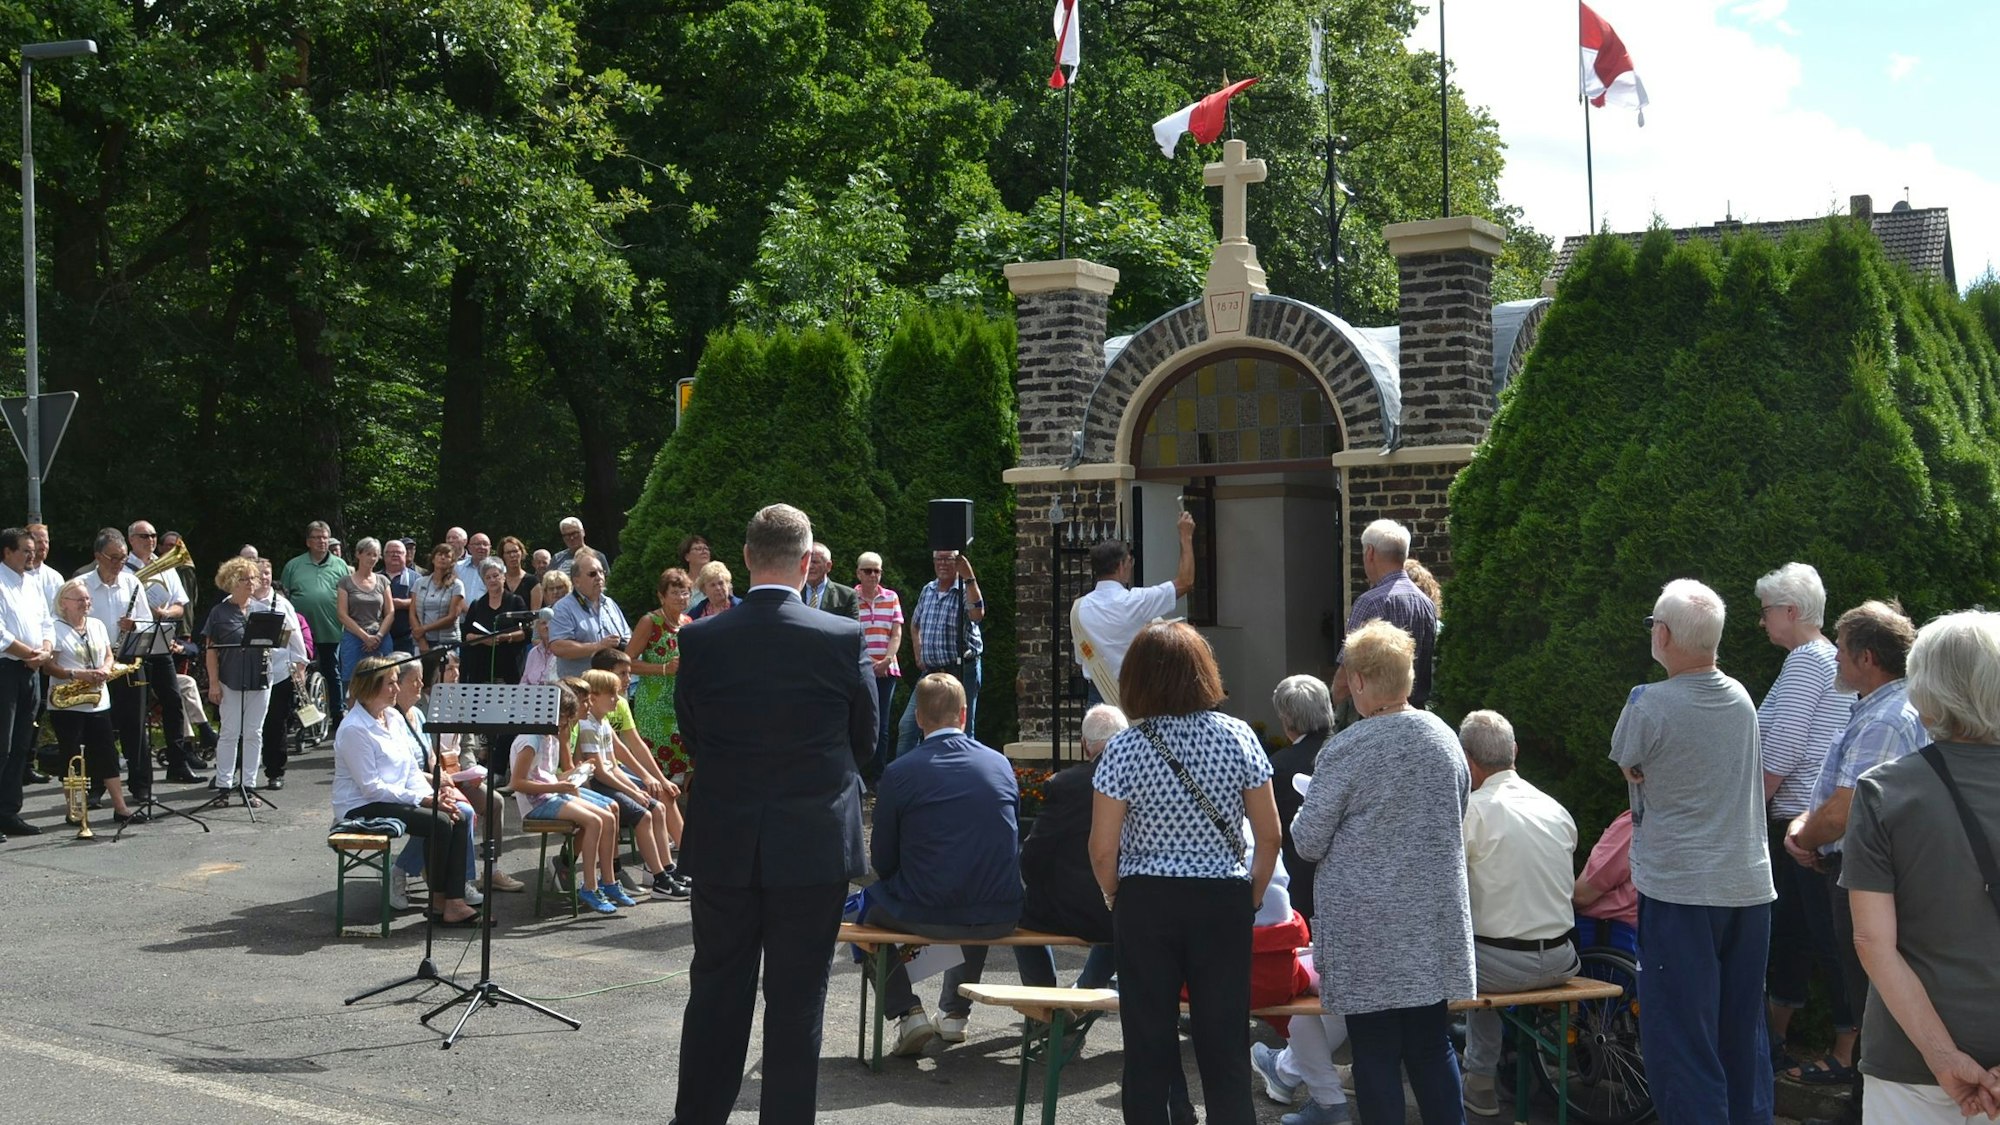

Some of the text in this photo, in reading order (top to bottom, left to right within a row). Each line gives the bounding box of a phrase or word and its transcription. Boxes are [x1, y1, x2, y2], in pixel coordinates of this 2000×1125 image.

[1150, 735, 1175, 763] RIGHT
[1177, 768, 1221, 823] THAT'S RIGHT
